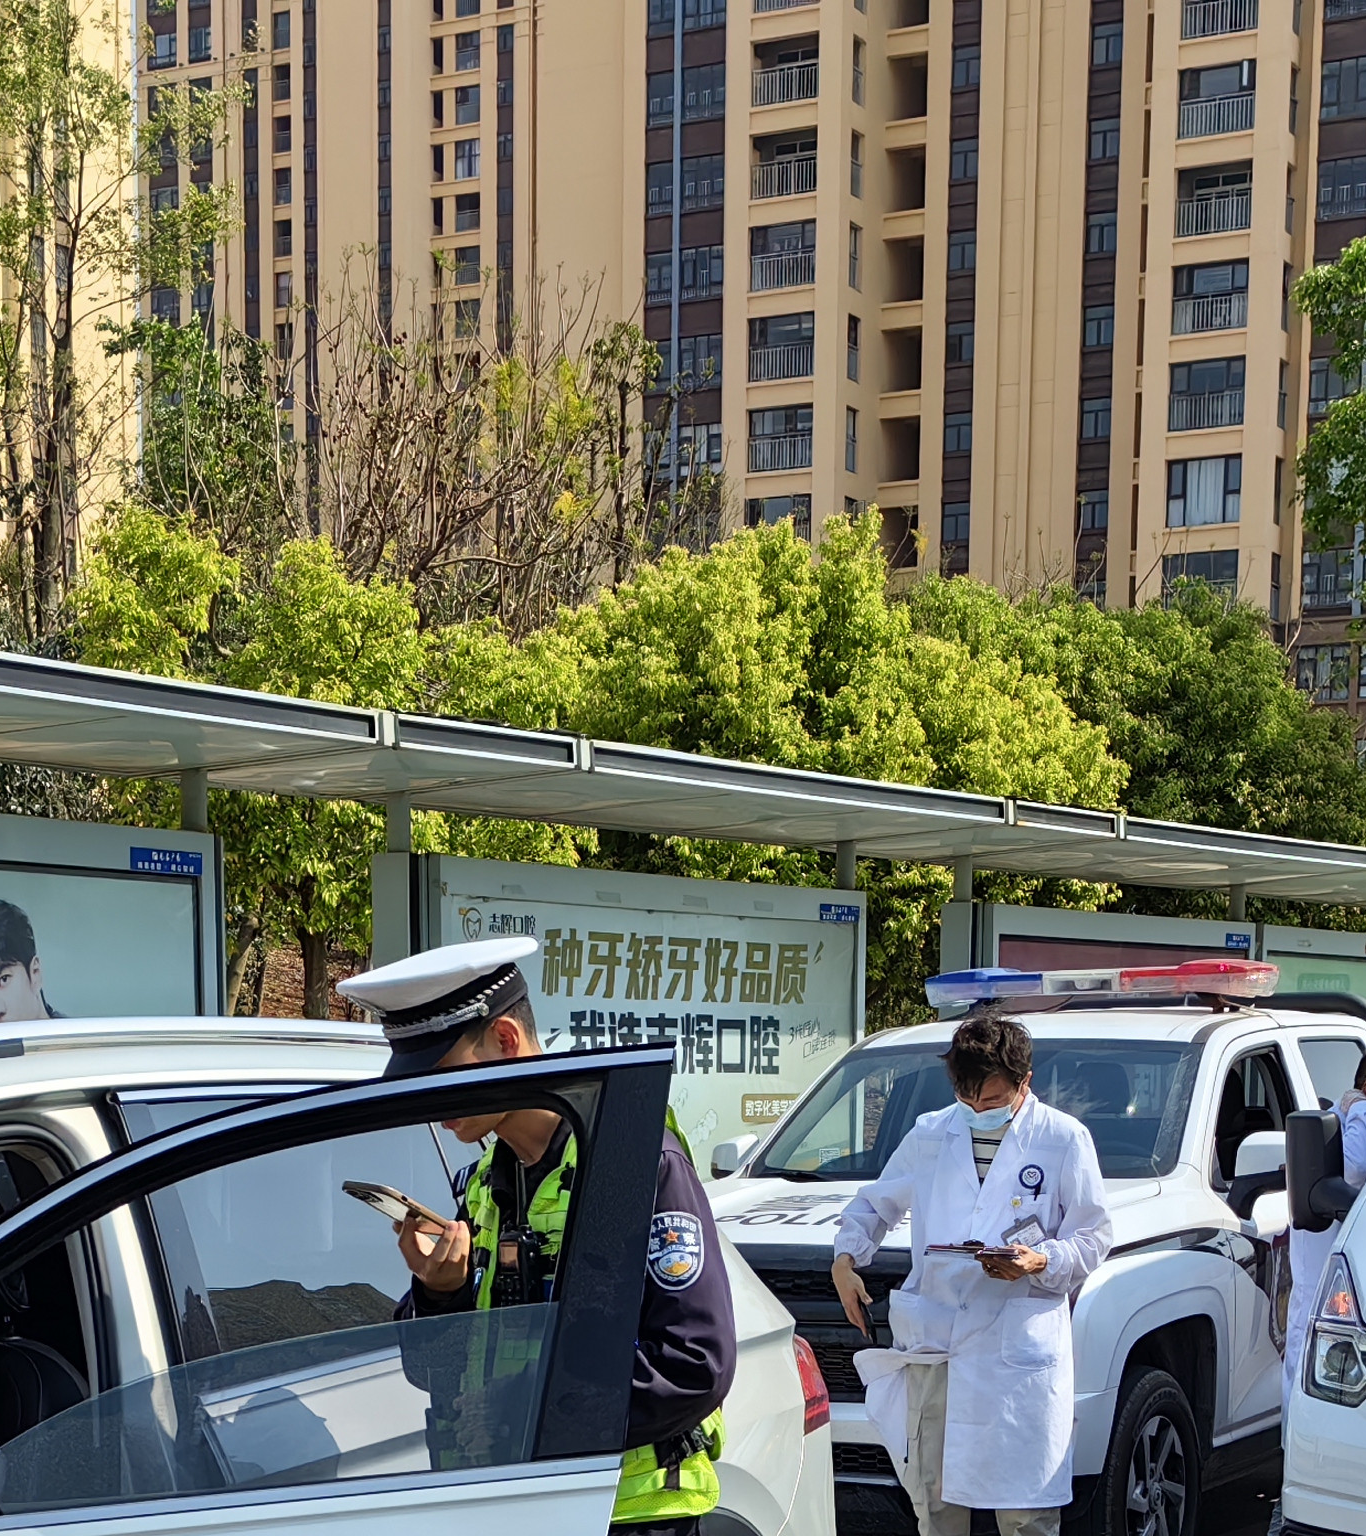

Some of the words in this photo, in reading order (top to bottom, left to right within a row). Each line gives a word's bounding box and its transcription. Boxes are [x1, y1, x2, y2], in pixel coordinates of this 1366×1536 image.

[541, 928, 808, 1005] 种牙矫牙好品质
[745, 1099, 795, 1117] 数字化美学
